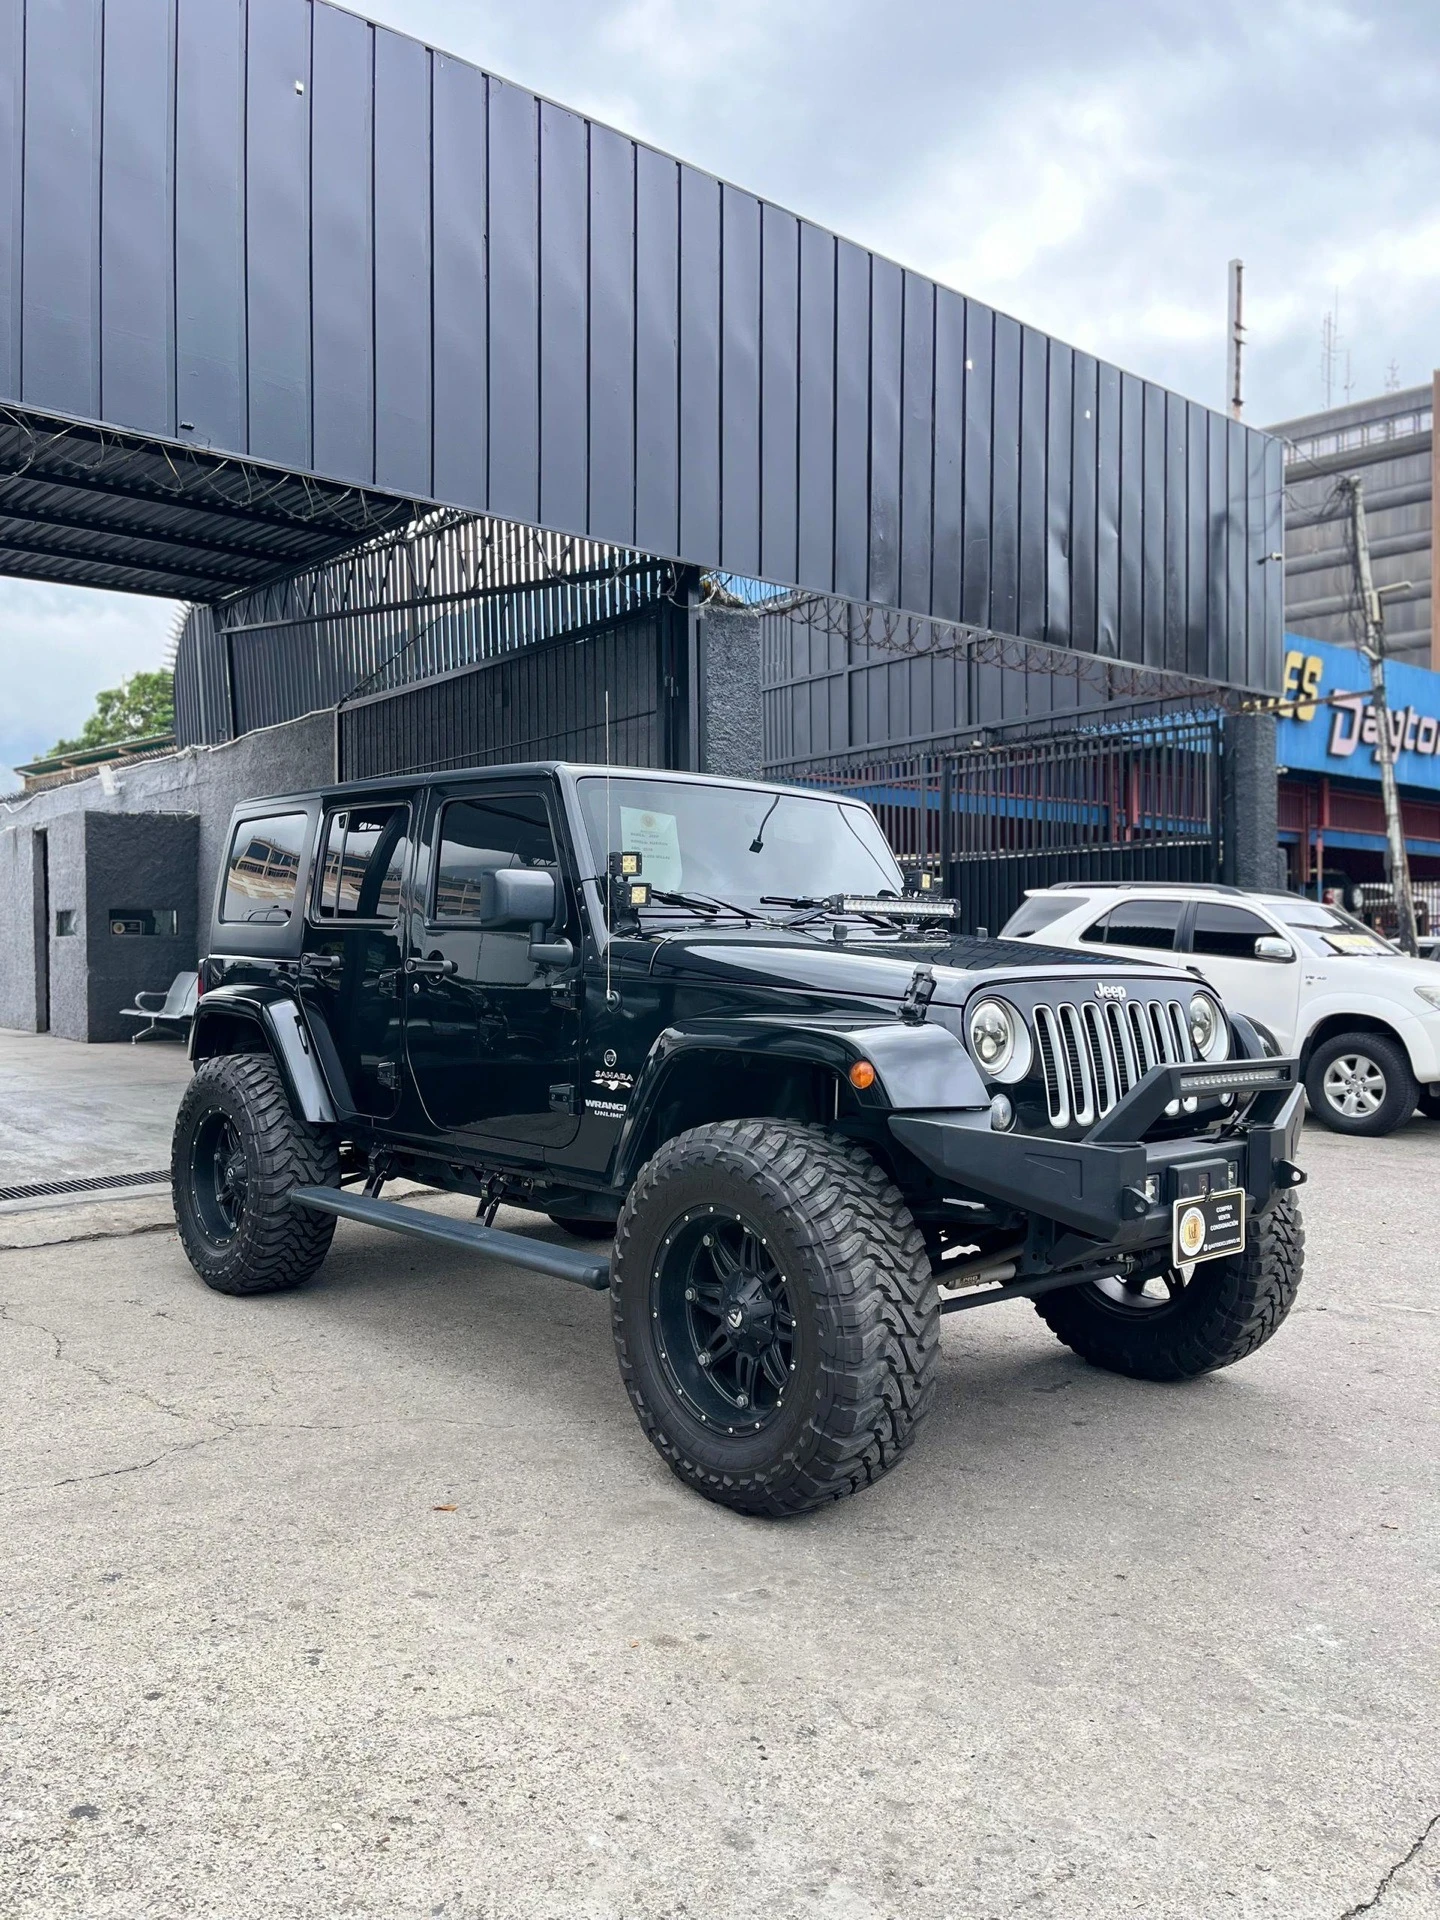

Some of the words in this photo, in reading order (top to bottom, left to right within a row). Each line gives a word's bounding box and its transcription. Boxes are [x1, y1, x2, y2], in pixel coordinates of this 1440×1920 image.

[1278, 650, 1323, 721] ES
[1329, 688, 1440, 764] Dayto
[1094, 982, 1127, 1002] Jeep
[595, 1070, 633, 1081] SAHARA
